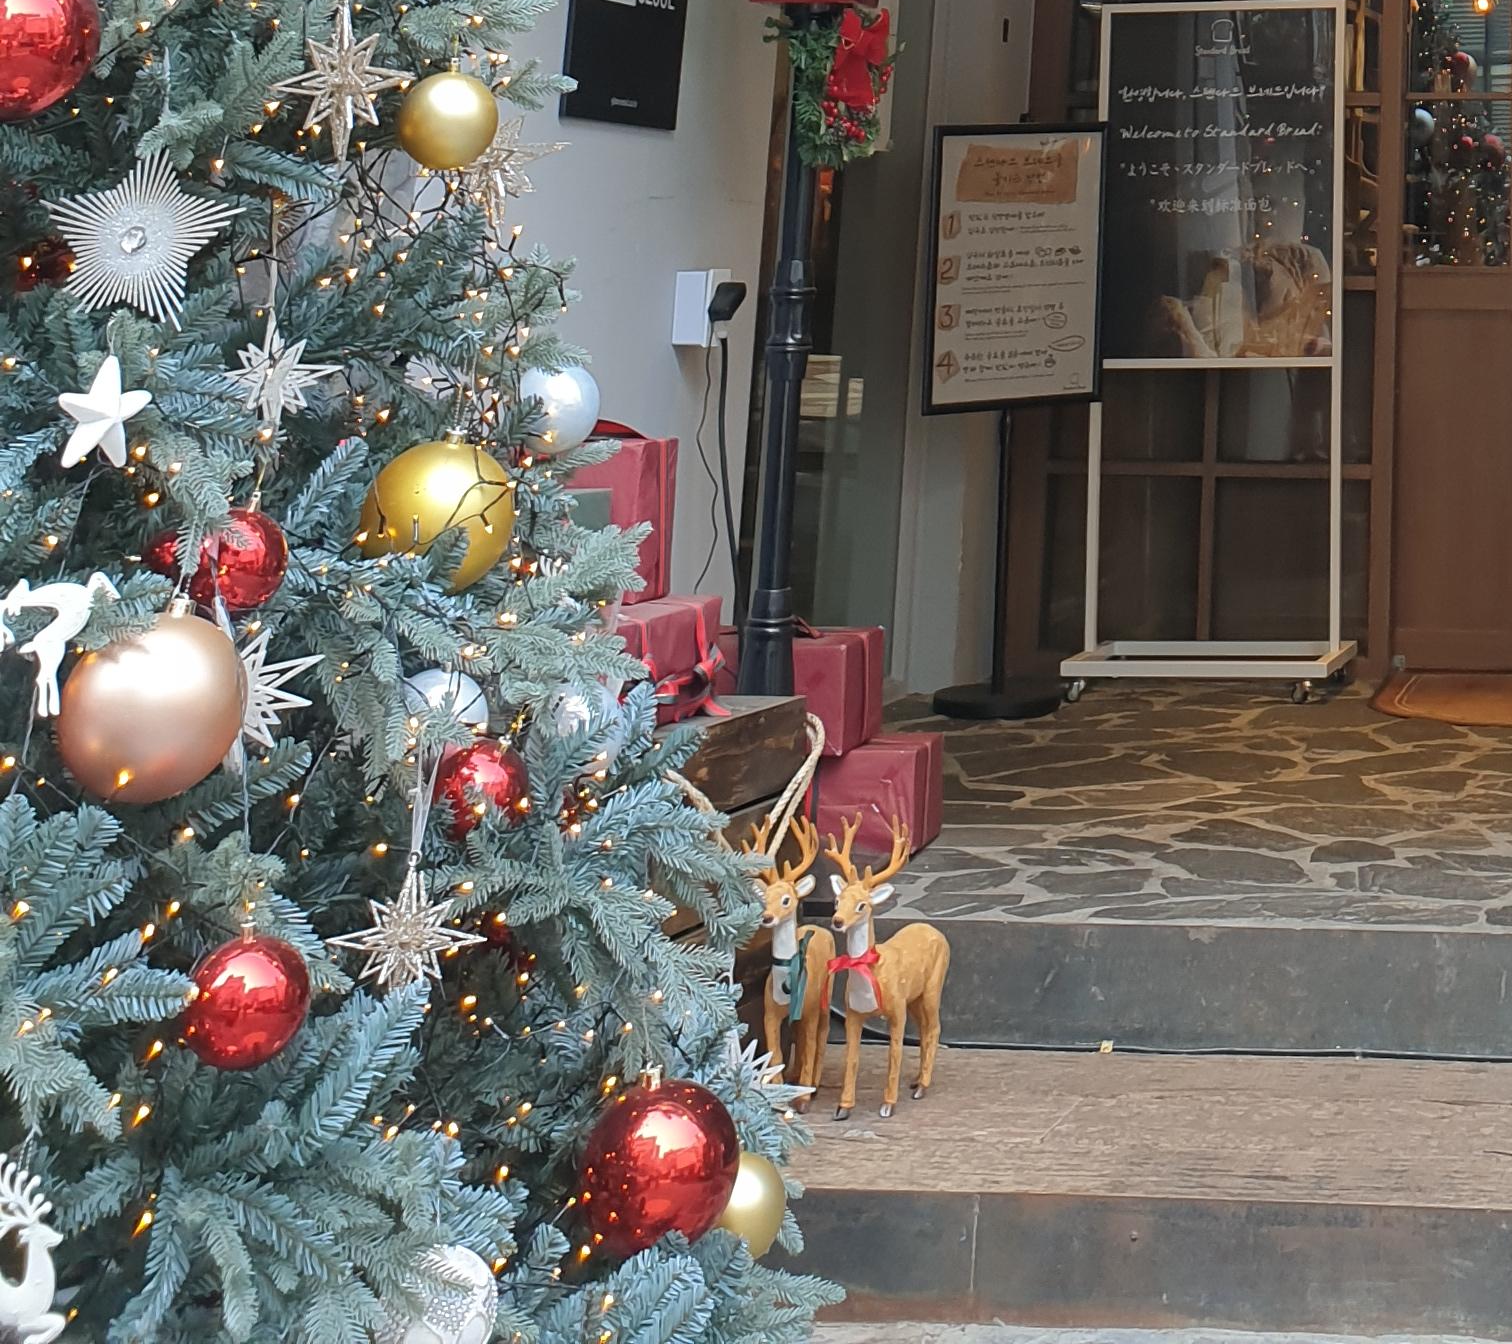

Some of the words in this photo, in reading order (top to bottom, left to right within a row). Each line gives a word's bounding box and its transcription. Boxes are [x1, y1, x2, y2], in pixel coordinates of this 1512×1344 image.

[1120, 124, 1183, 139] Welcome
[1184, 125, 1199, 139] to
[1203, 122, 1275, 138] Standard
[947, 214, 954, 231] 1
[940, 257, 954, 280] 2
[939, 304, 953, 328] 3
[935, 350, 954, 375] 4
